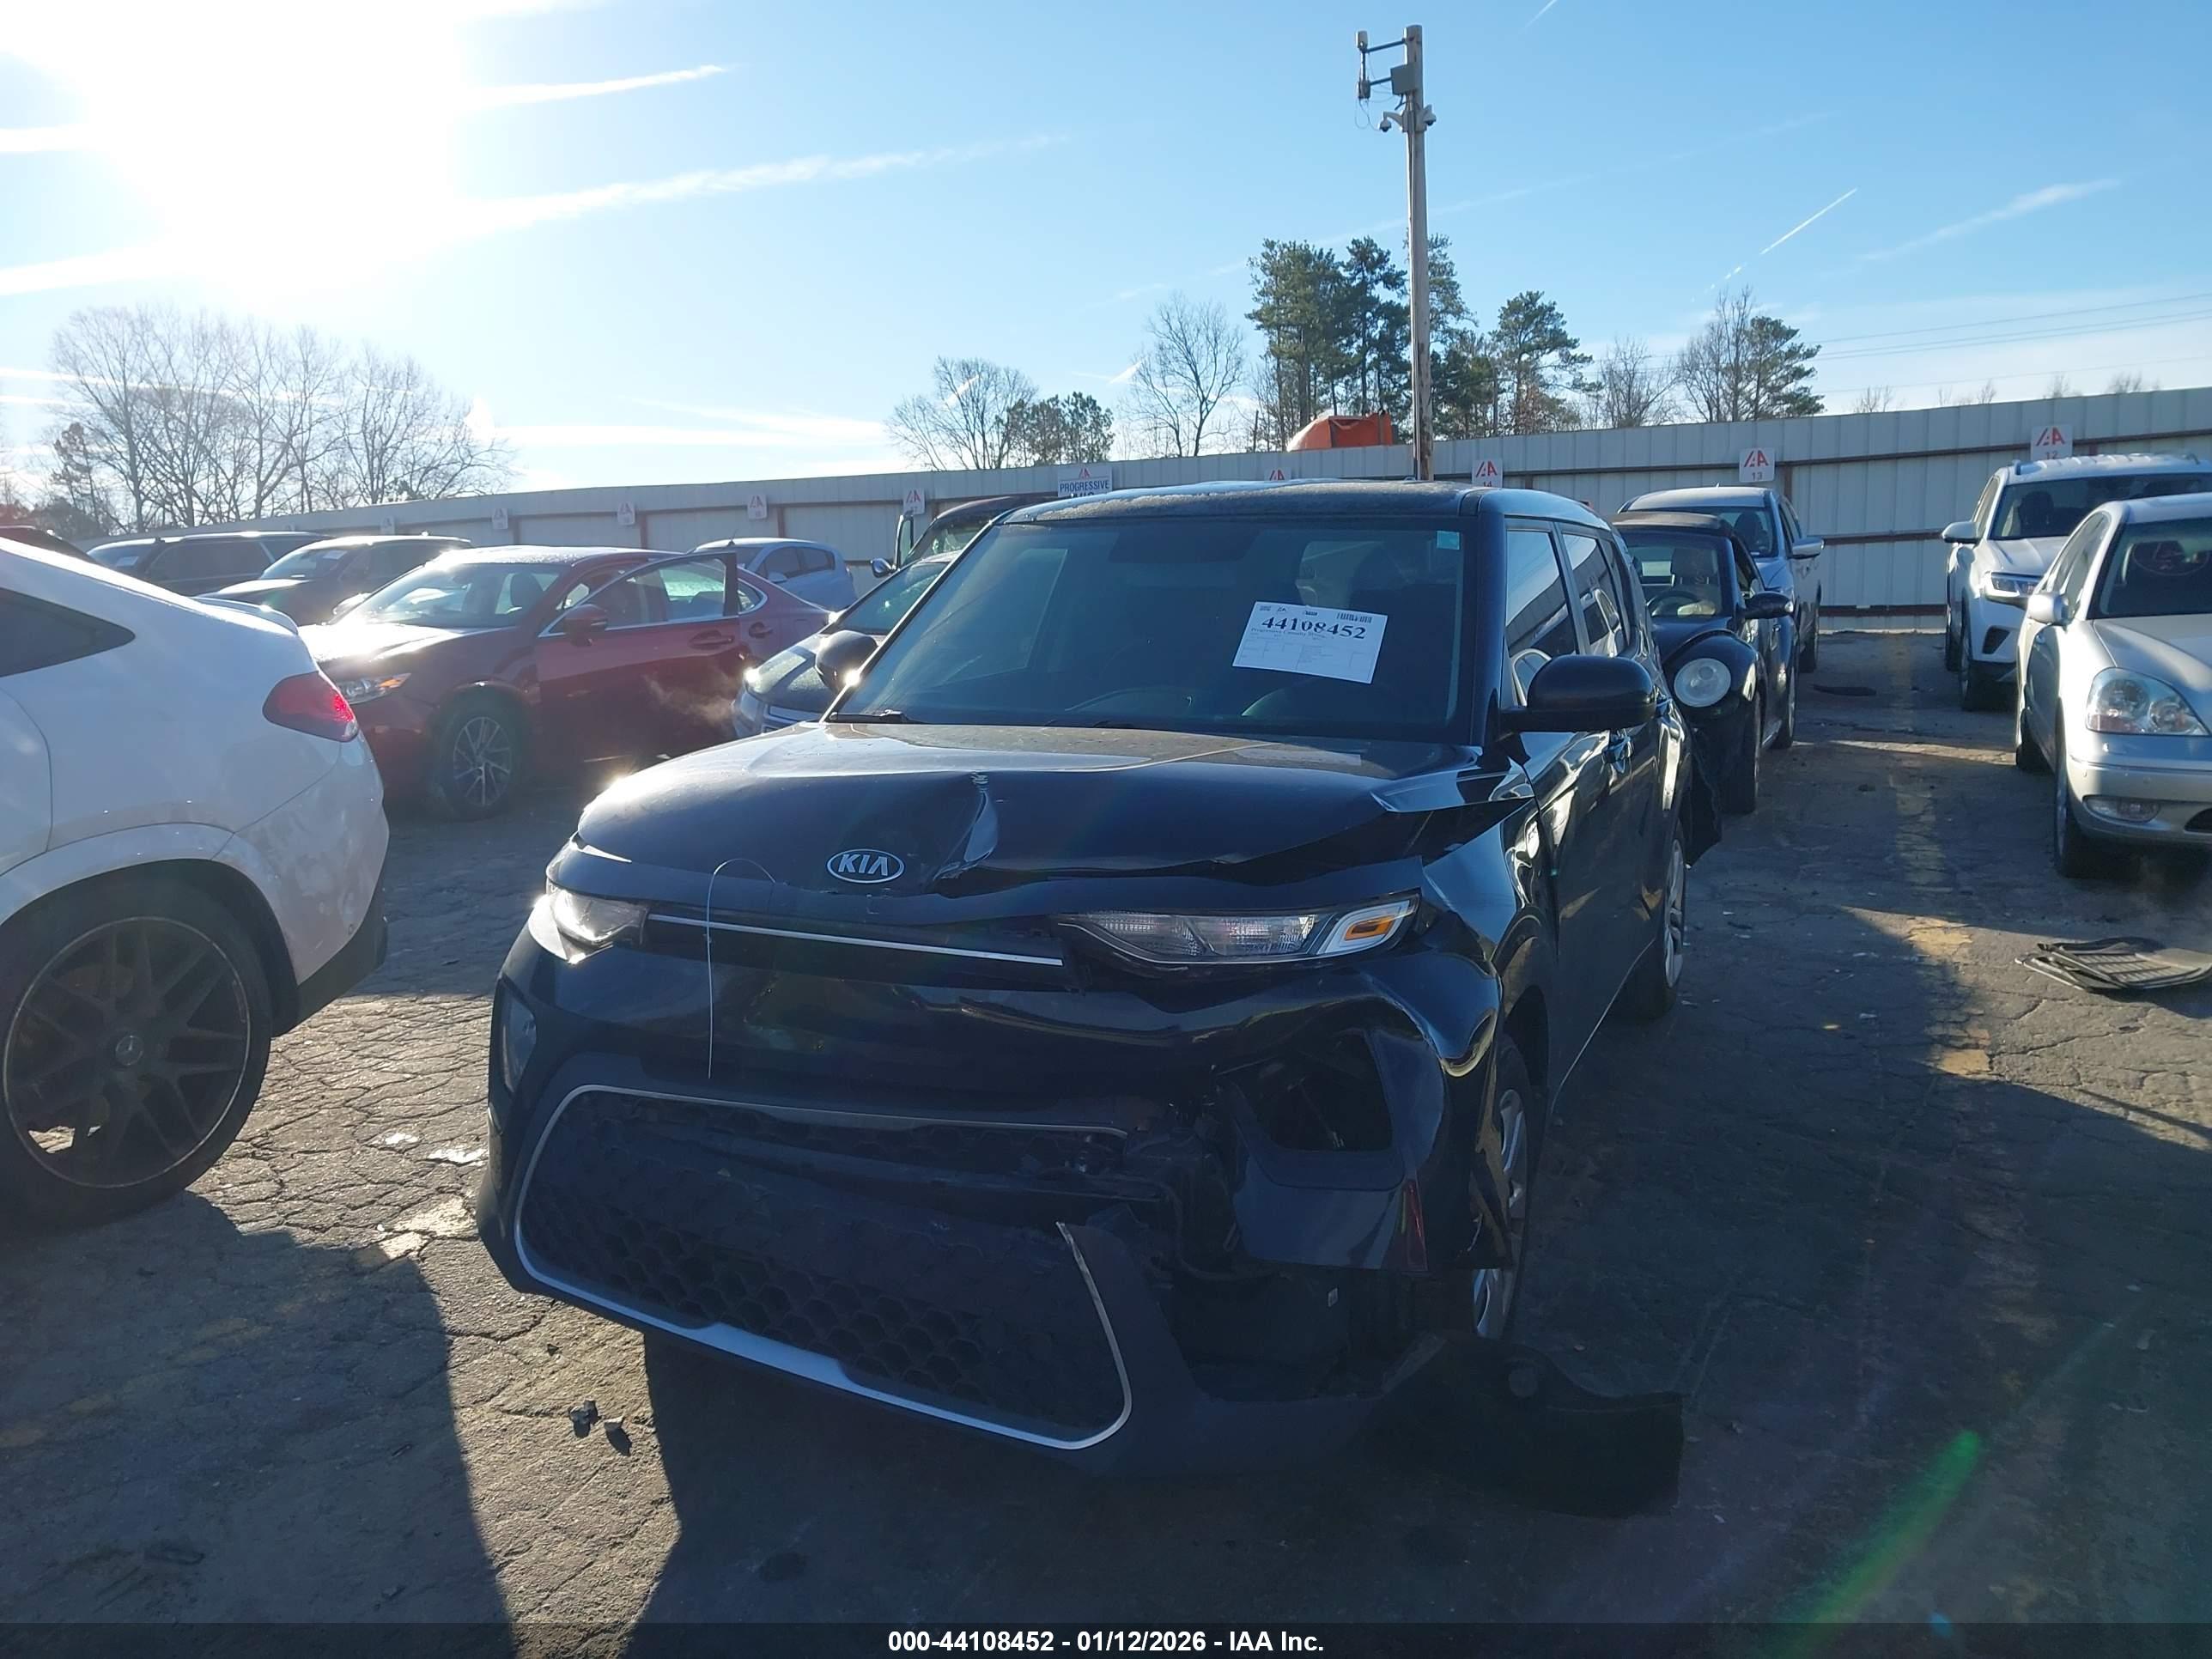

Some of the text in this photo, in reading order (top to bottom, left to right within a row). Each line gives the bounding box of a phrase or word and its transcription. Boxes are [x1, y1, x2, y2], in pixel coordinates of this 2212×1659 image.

[1060, 479, 1110, 494] PROGRESSIVE
[1261, 616, 1366, 640] 44108452
[838, 854, 888, 876] KIA
